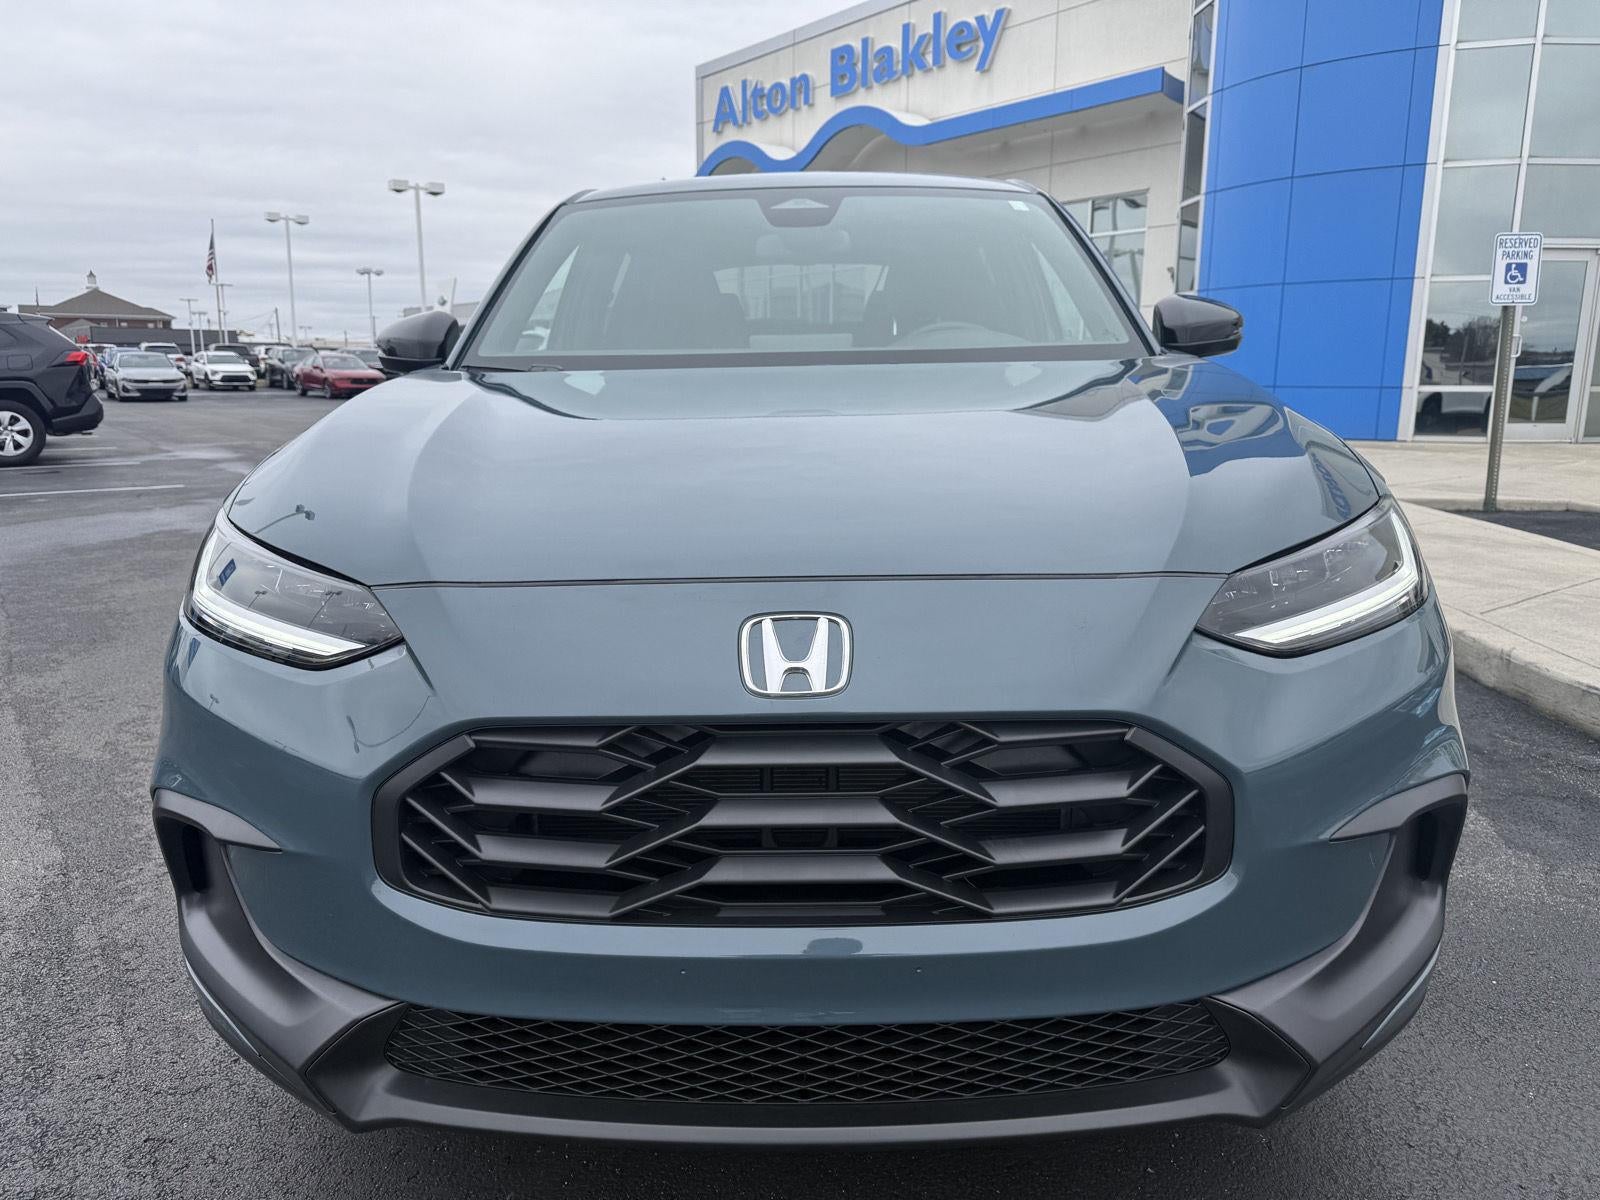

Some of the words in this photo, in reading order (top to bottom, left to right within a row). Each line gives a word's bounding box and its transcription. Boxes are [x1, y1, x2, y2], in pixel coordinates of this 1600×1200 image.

[713, 72, 814, 133] Alton
[830, 7, 1011, 98] Blakley
[1499, 238, 1539, 249] RESERVED
[1501, 250, 1534, 260] PARKING
